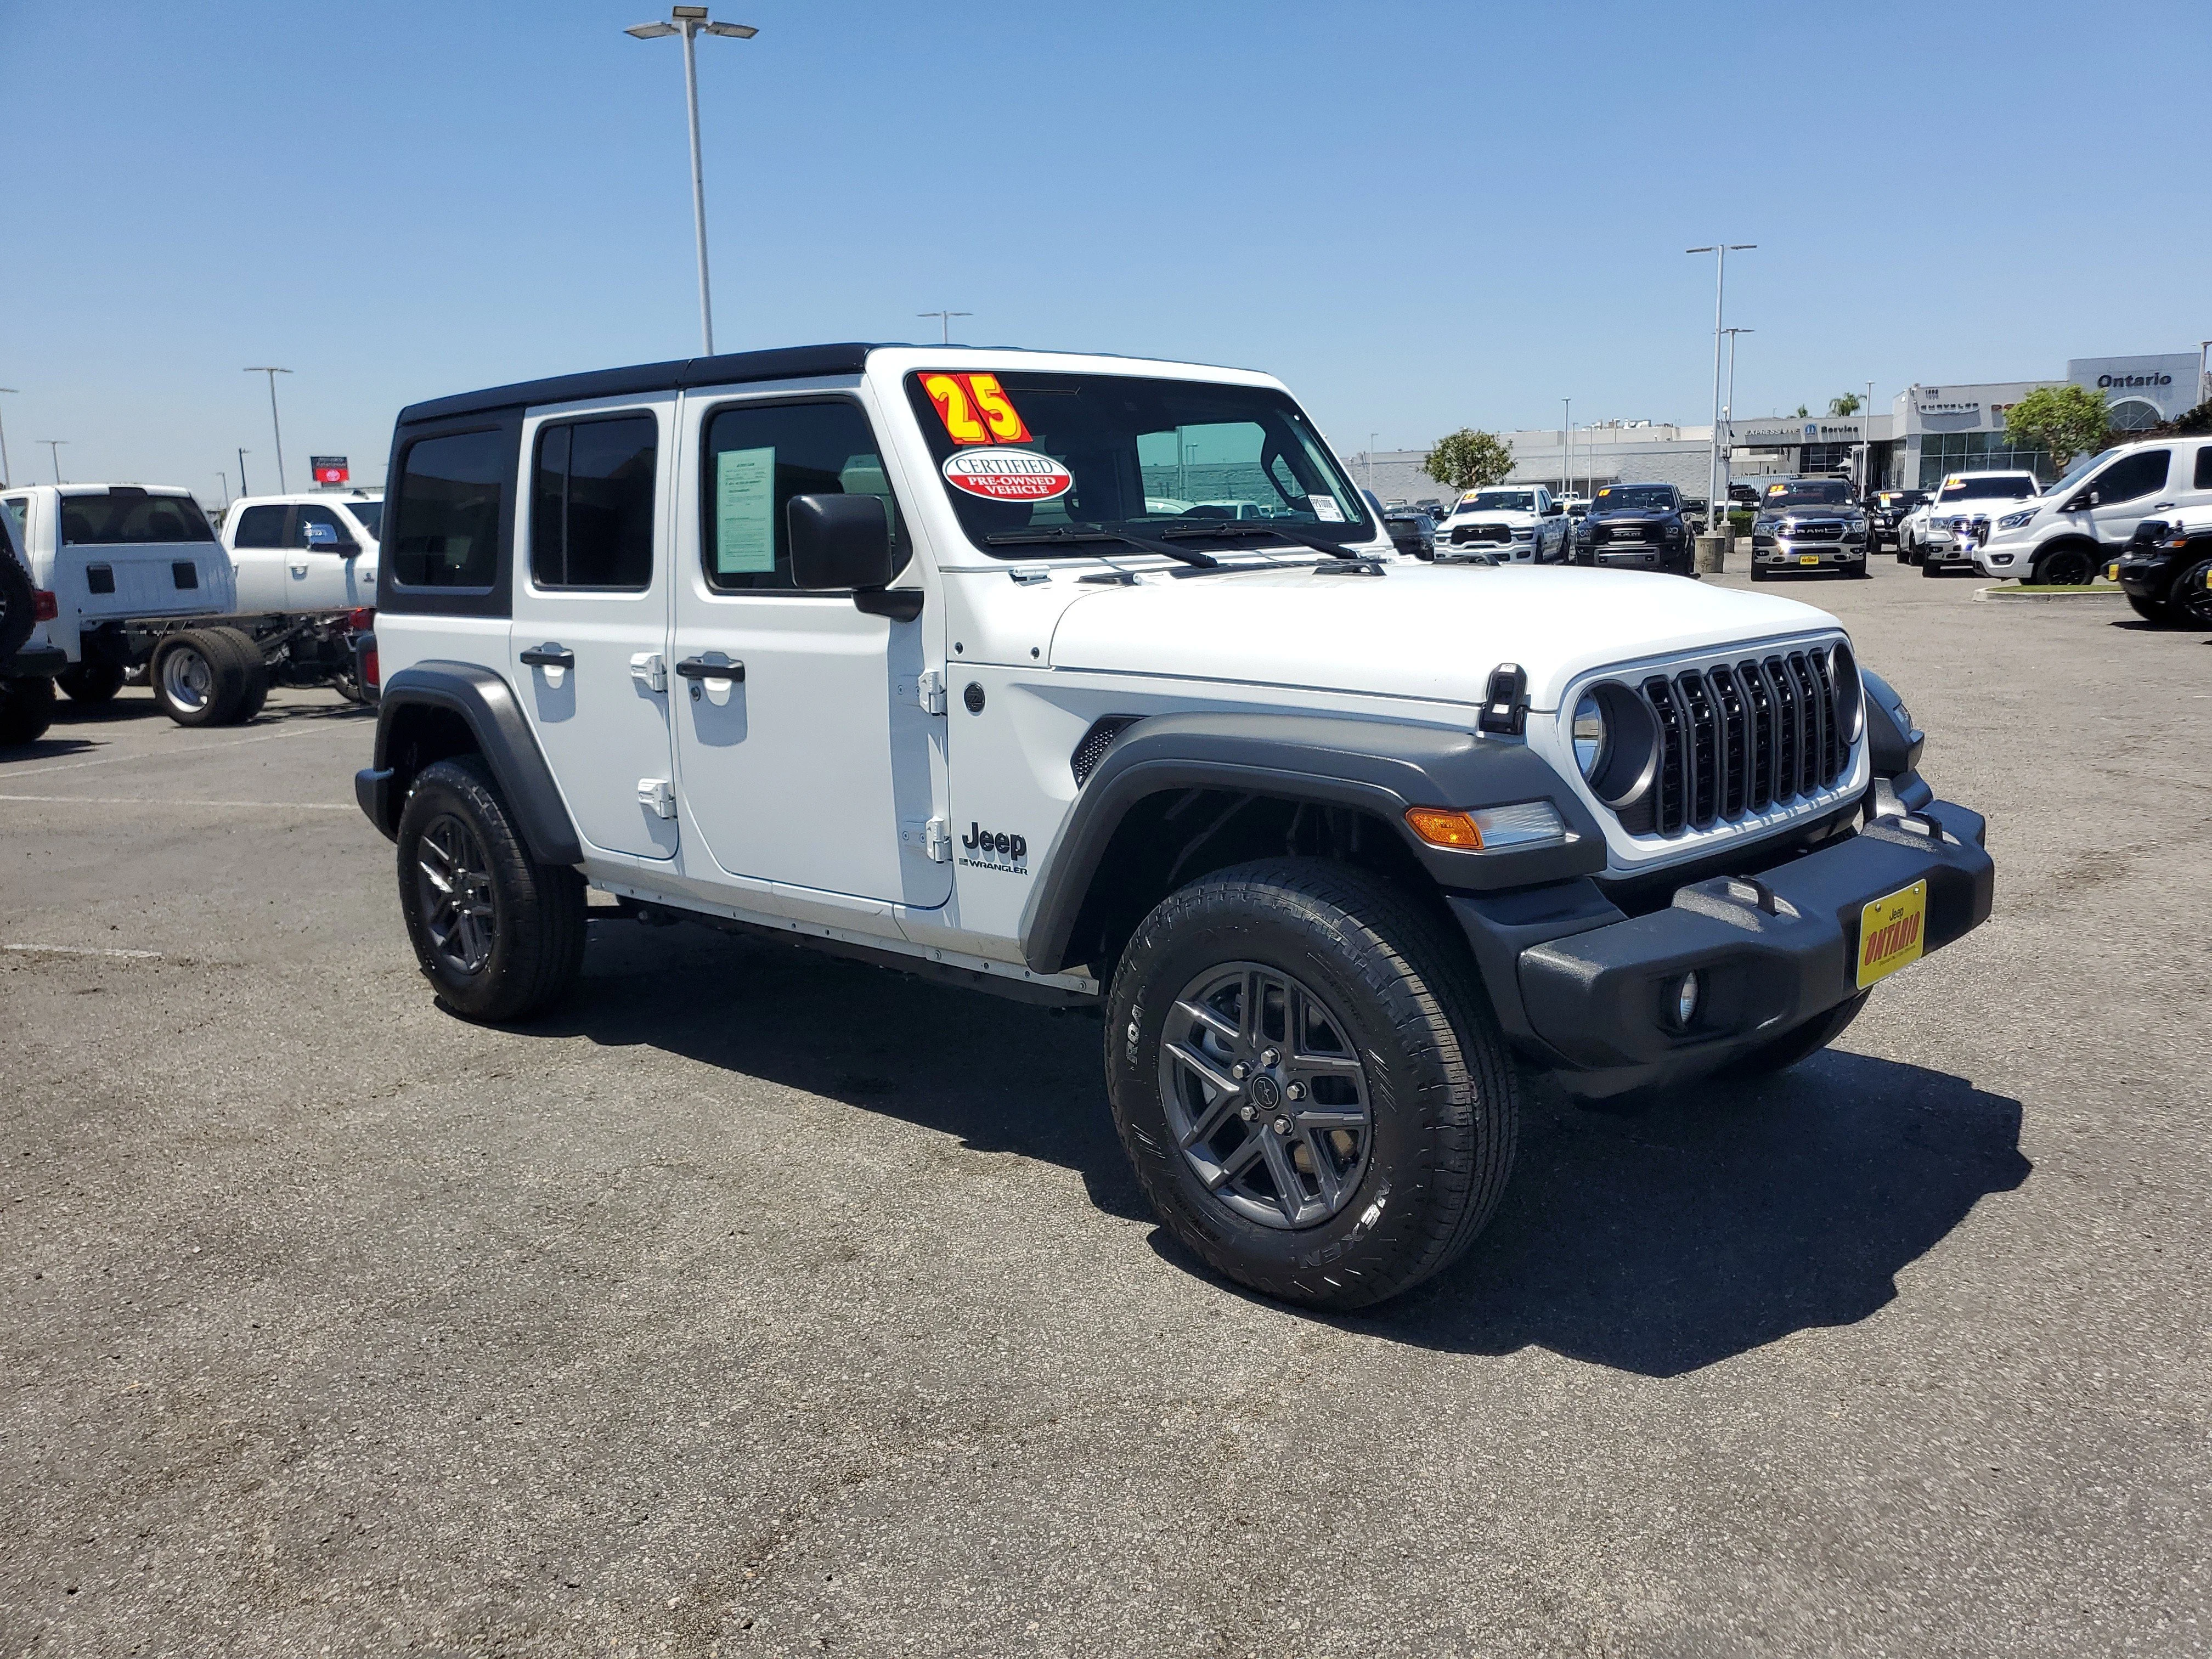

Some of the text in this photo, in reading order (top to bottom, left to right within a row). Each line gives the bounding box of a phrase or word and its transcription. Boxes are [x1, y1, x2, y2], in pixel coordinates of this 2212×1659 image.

[2097, 372, 2172, 388] Ontario
[926, 375, 1022, 441] 25
[1821, 425, 1859, 433] Service
[955, 459, 1053, 474] CERTIFIED
[967, 476, 1056, 486] PRE-OWNED
[984, 484, 1050, 494] VEHICLE
[962, 821, 1028, 861] Jeep
[968, 859, 1028, 876] WRANGLER
[1889, 906, 1904, 922] Jeep
[1864, 910, 1921, 966] ONTARIO
